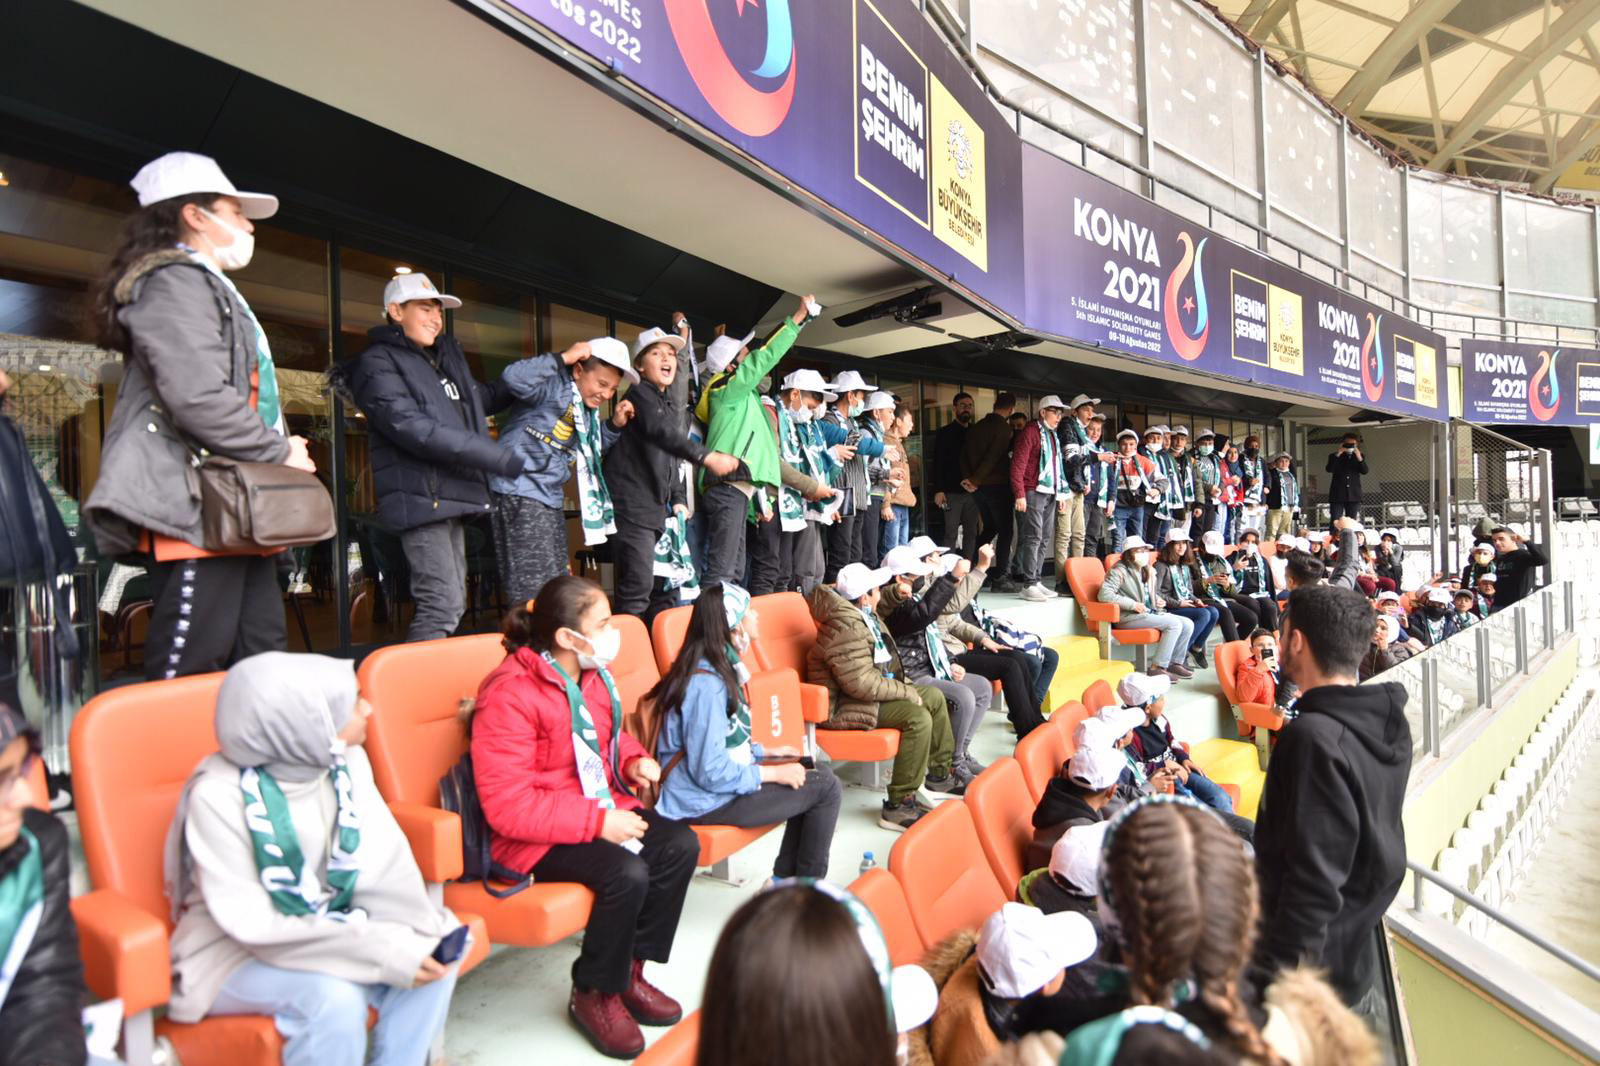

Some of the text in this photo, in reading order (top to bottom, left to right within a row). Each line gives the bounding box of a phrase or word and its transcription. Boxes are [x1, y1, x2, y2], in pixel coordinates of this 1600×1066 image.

[589, 9, 642, 64] 2022
[860, 44, 924, 140] BENİM
[861, 98, 924, 180] ŞEHRİM
[950, 177, 972, 209] KONYA
[1073, 197, 1161, 268] KONYA
[1103, 260, 1161, 312] 2021
[1111, 320, 1143, 336] SOLIDARITY
[1143, 329, 1161, 341] GAMES
[1318, 301, 1360, 340] KONYA
[1332, 339, 1360, 371] 2021
[1474, 352, 1527, 375] KONYA
[1491, 378, 1527, 399] 2021
